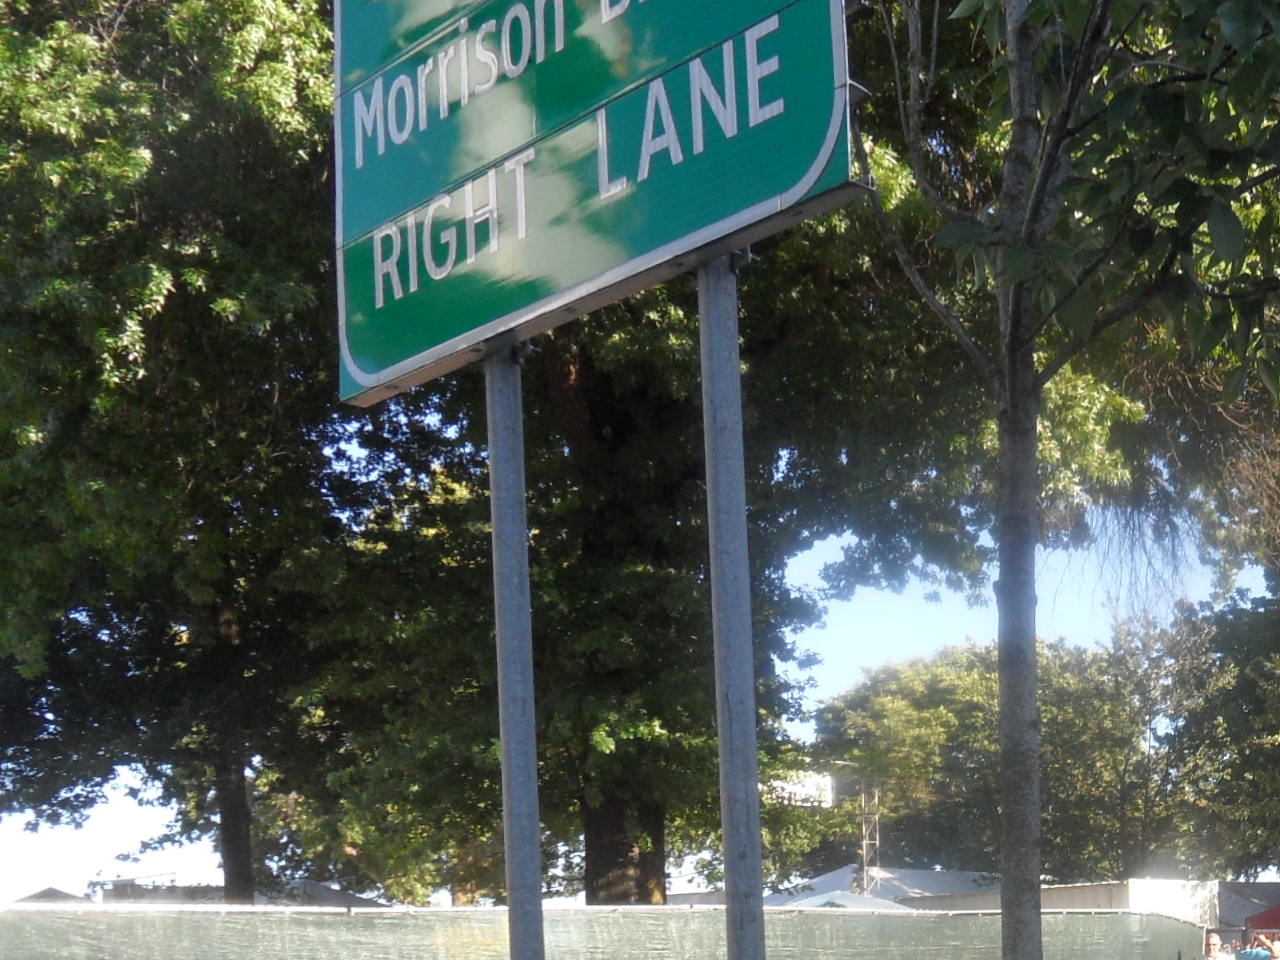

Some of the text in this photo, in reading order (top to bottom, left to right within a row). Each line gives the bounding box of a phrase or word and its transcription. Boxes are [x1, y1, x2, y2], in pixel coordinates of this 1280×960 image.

[354, 0, 565, 169] Morrison
[373, 14, 784, 308] RIGHT LANE
